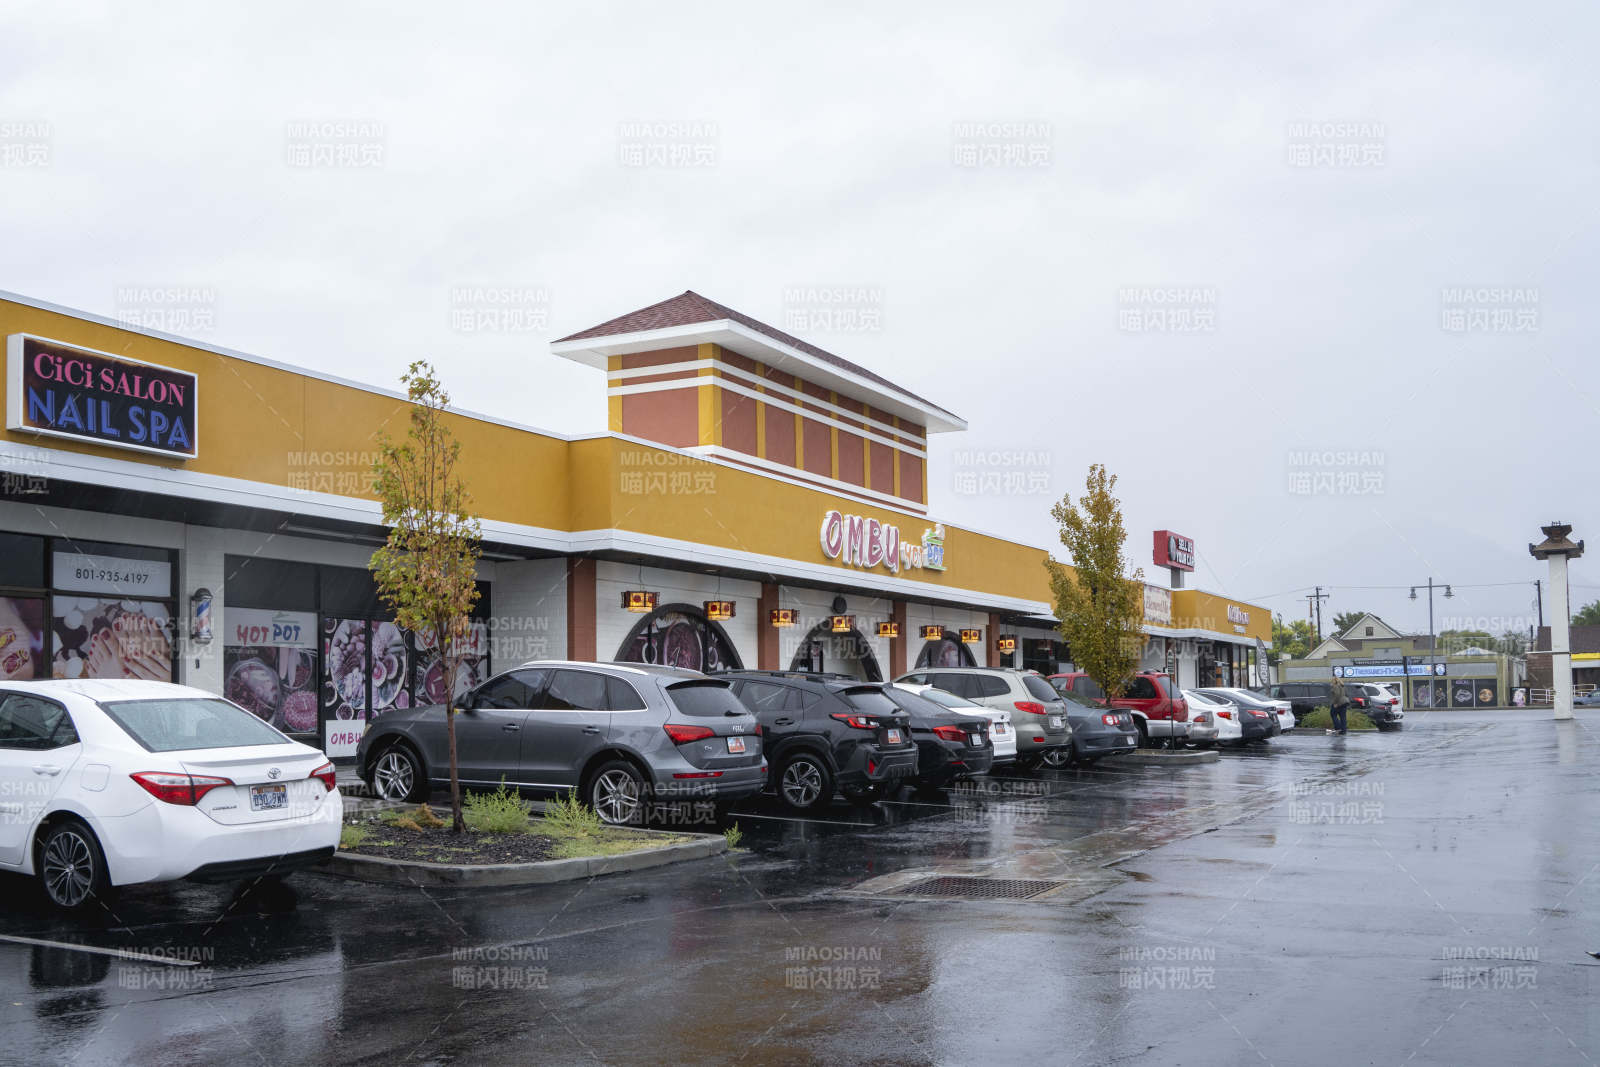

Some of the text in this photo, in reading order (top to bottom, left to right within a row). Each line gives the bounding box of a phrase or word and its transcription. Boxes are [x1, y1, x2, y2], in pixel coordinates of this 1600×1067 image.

[33, 352, 185, 407] CiCi SALON
[27, 385, 192, 450] NAIL SPA
[820, 509, 900, 574] OMBU
[1178, 537, 1187, 552] SELL
[1175, 551, 1187, 566] YOUR
[75, 568, 149, 585] 801-935-4197
[236, 623, 301, 648] HOT POT
